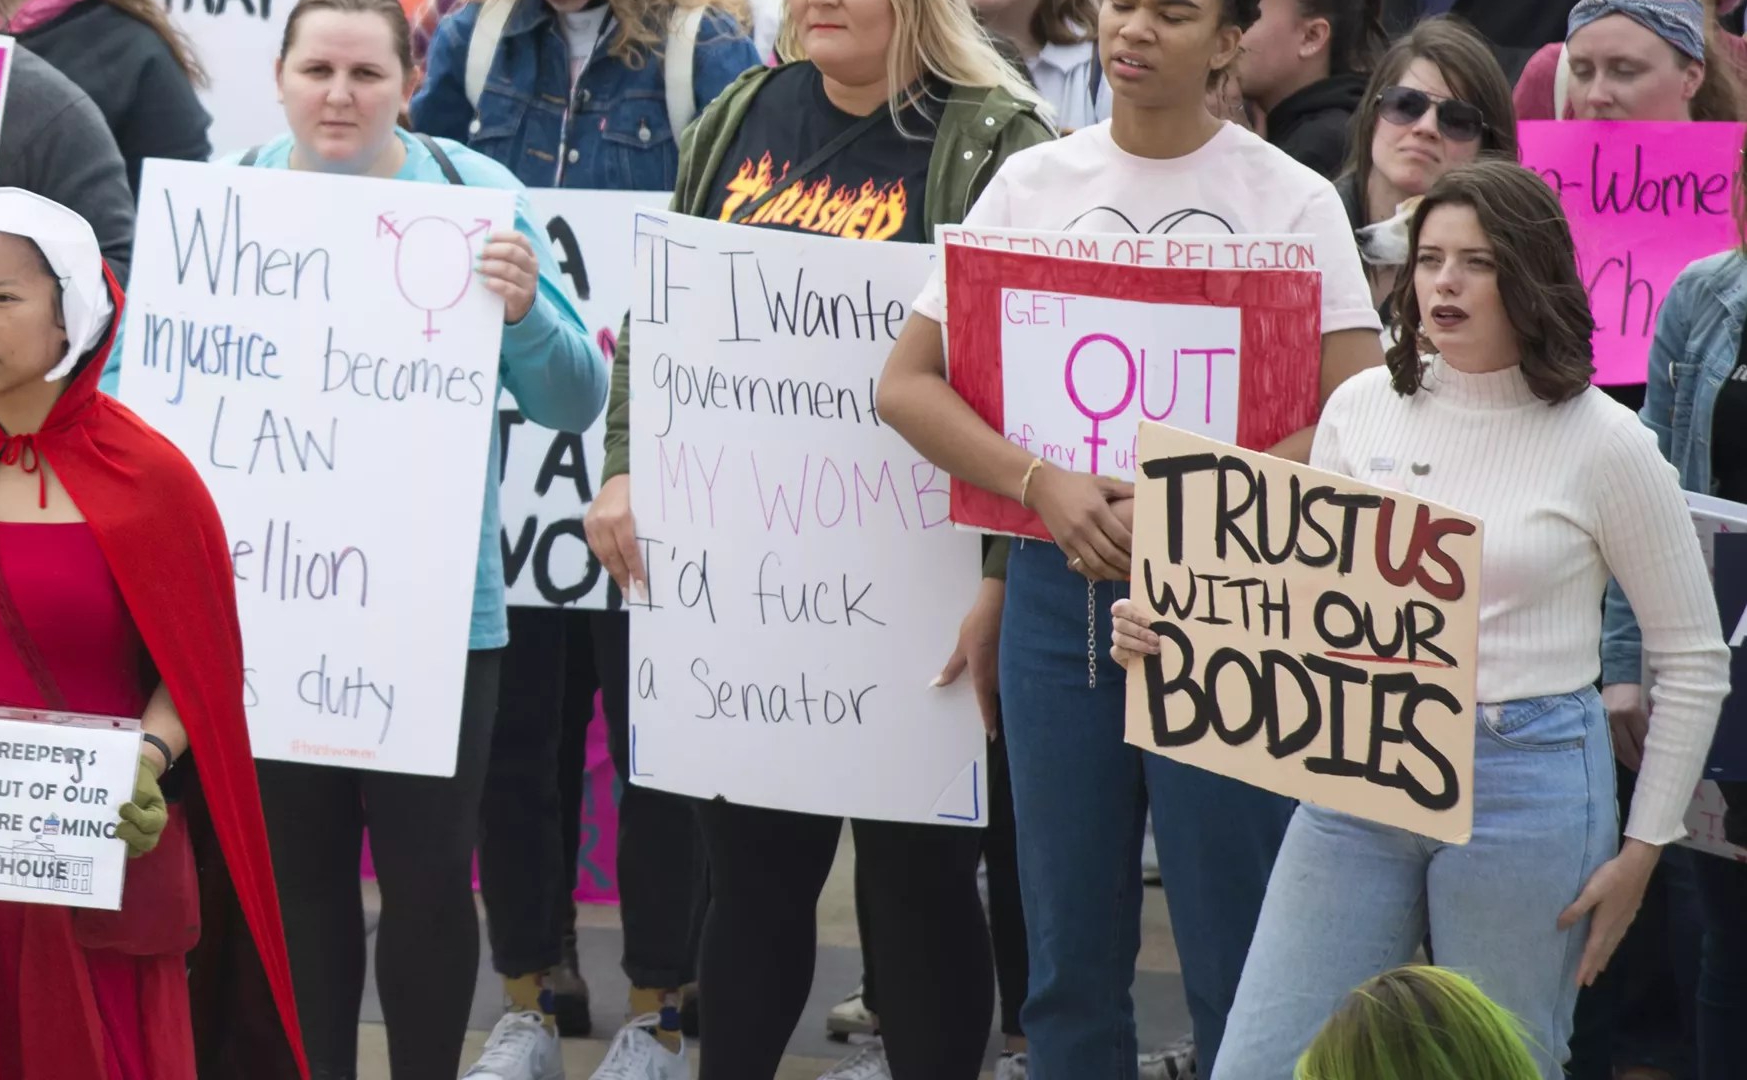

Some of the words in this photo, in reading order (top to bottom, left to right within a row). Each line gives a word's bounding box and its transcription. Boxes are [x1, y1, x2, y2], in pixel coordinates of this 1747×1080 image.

[164, 187, 331, 302] When
[636, 231, 697, 324] IF
[719, 250, 761, 342] I
[1113, 239, 1155, 264] OF
[1166, 239, 1316, 269] RELIGION
[1004, 291, 1077, 328] GET
[143, 305, 284, 406] injustice
[320, 326, 486, 407] becomes
[1064, 332, 1236, 425] OUT
[209, 395, 338, 475] LAW
[1042, 442, 1076, 471] my
[659, 439, 725, 528] MY
[751, 449, 952, 535] WOMB
[1140, 452, 1383, 576] TRUST
[1374, 496, 1477, 602] US
[628, 536, 717, 624] I'd
[752, 551, 887, 626] fuck
[1144, 557, 1290, 641] WITH
[1313, 590, 1458, 668] OUR
[297, 653, 394, 745] duty
[638, 657, 658, 701] a
[690, 657, 878, 725] Senator
[1143, 621, 1463, 811] BODIES
[28, 782, 57, 802] OF
[62, 786, 109, 806] OUR
[0, 856, 69, 881] HOUSE
